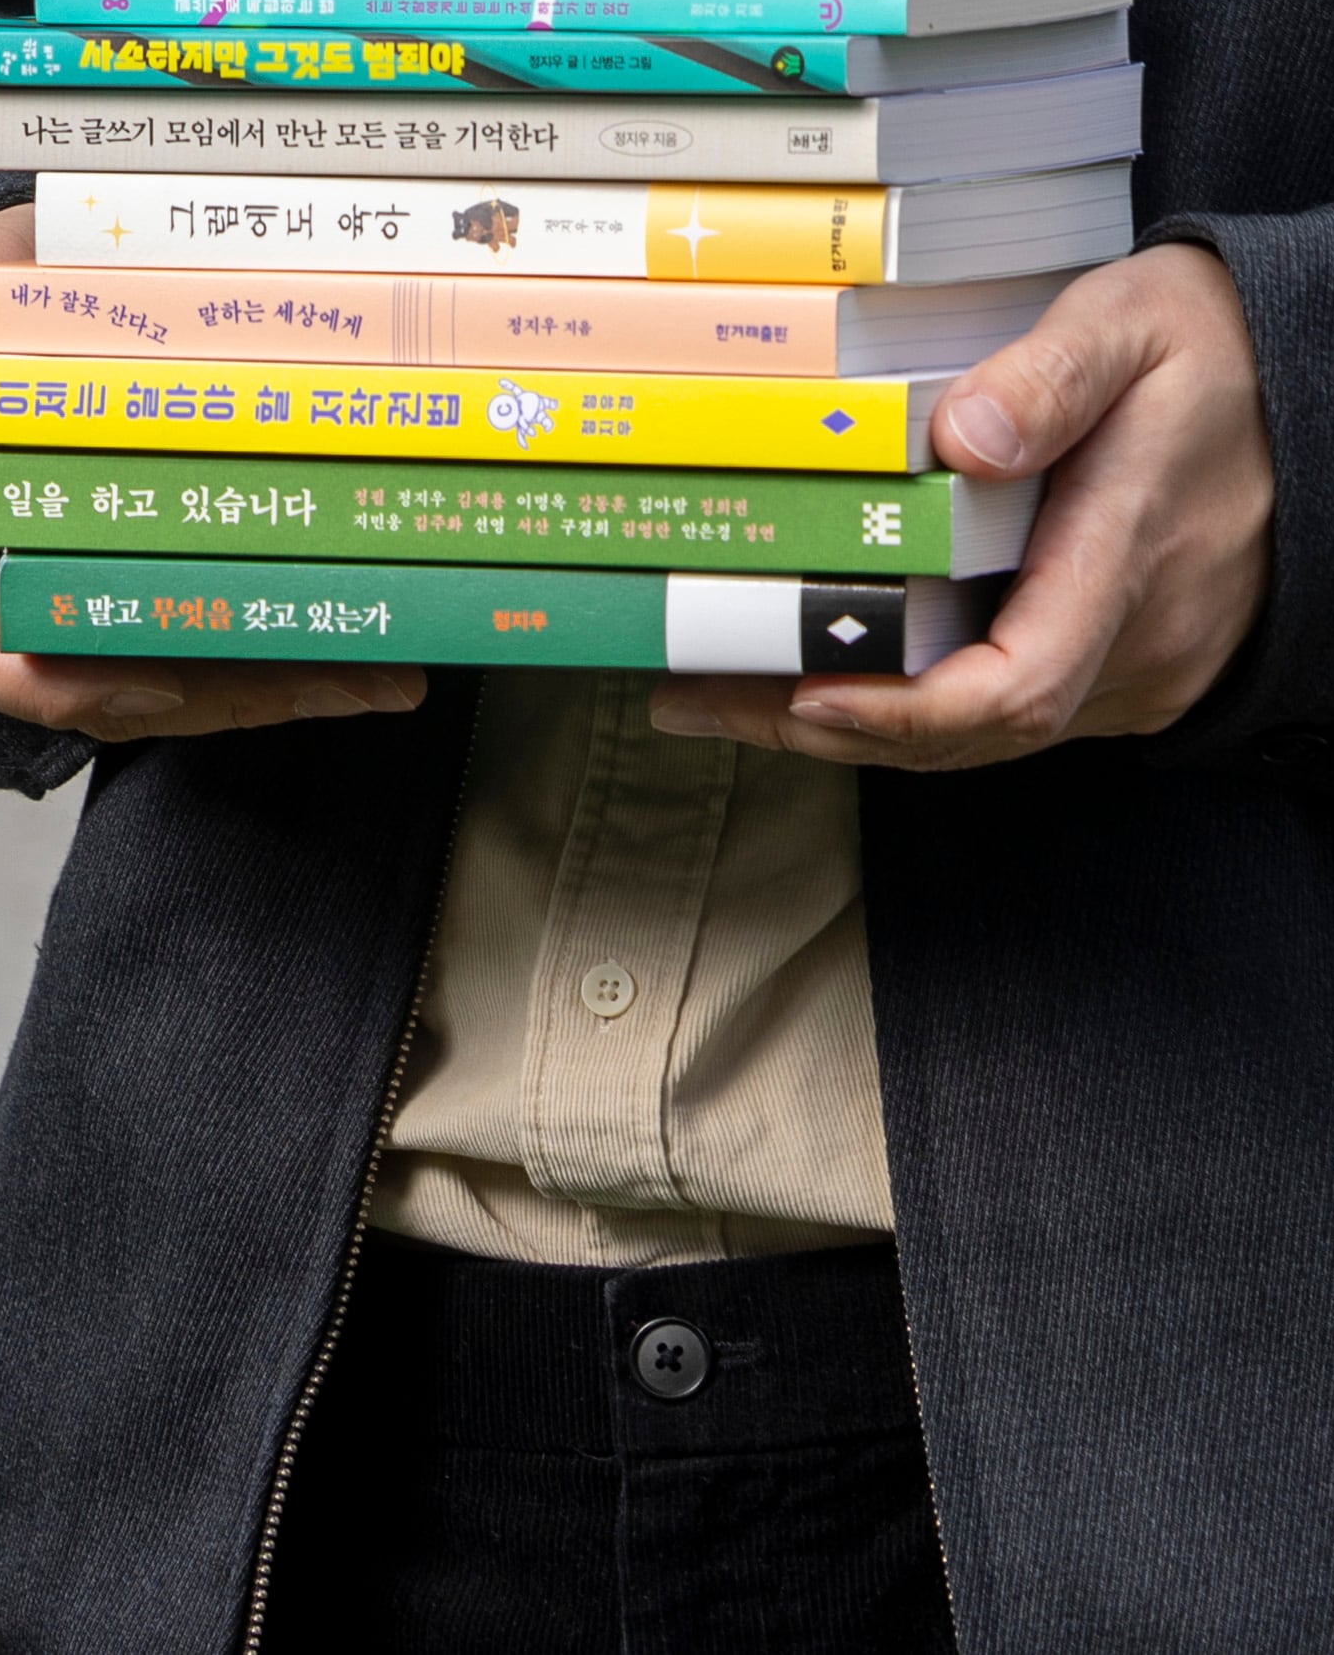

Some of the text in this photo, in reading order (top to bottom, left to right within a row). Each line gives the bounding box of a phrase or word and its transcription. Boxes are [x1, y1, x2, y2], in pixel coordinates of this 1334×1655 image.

[365, 0, 392, 13] 쓰는
[398, 0, 467, 14] 사람에게는
[505, 1, 531, 15] 구석
[538, 2, 579, 15] 하나가
[585, 2, 596, 16] 더
[603, 2, 629, 16] 있다
[79, 40, 465, 80] 사소하지만 그것도 범죄야
[529, 55, 563, 69] 정지우
[22, 116, 559, 152] 나는 글쓰기 모임에서 만난 모든 글을 기억한다
[615, 131, 677, 148] 정지우 지음
[169, 200, 411, 241] 그럼에도 육아
[544, 217, 624, 235] 정지우 지음
[10, 284, 363, 345] 내가 잘못 산다고 말하는 세상에게
[507, 315, 592, 337] 정지우 지음
[715, 323, 788, 343] 한겨레출판
[126, 381, 236, 421] 알아야
[255, 385, 290, 423] 할
[310, 386, 461, 427] 저작권법
[581, 419, 632, 437] 정지우
[3, 481, 69, 519] 일을
[91, 483, 158, 522] 하고
[181, 485, 317, 527] 있습니다
[397, 488, 446, 508] 정지우
[638, 495, 688, 515] 김아람
[354, 512, 402, 531] 지민웅
[474, 515, 505, 535] 선영
[560, 518, 609, 538] 구경희
[681, 521, 730, 541] 안은경
[49, 595, 391, 635] 돈 말고 무엇을 갖고 있는가
[494, 610, 548, 631] 정지우
